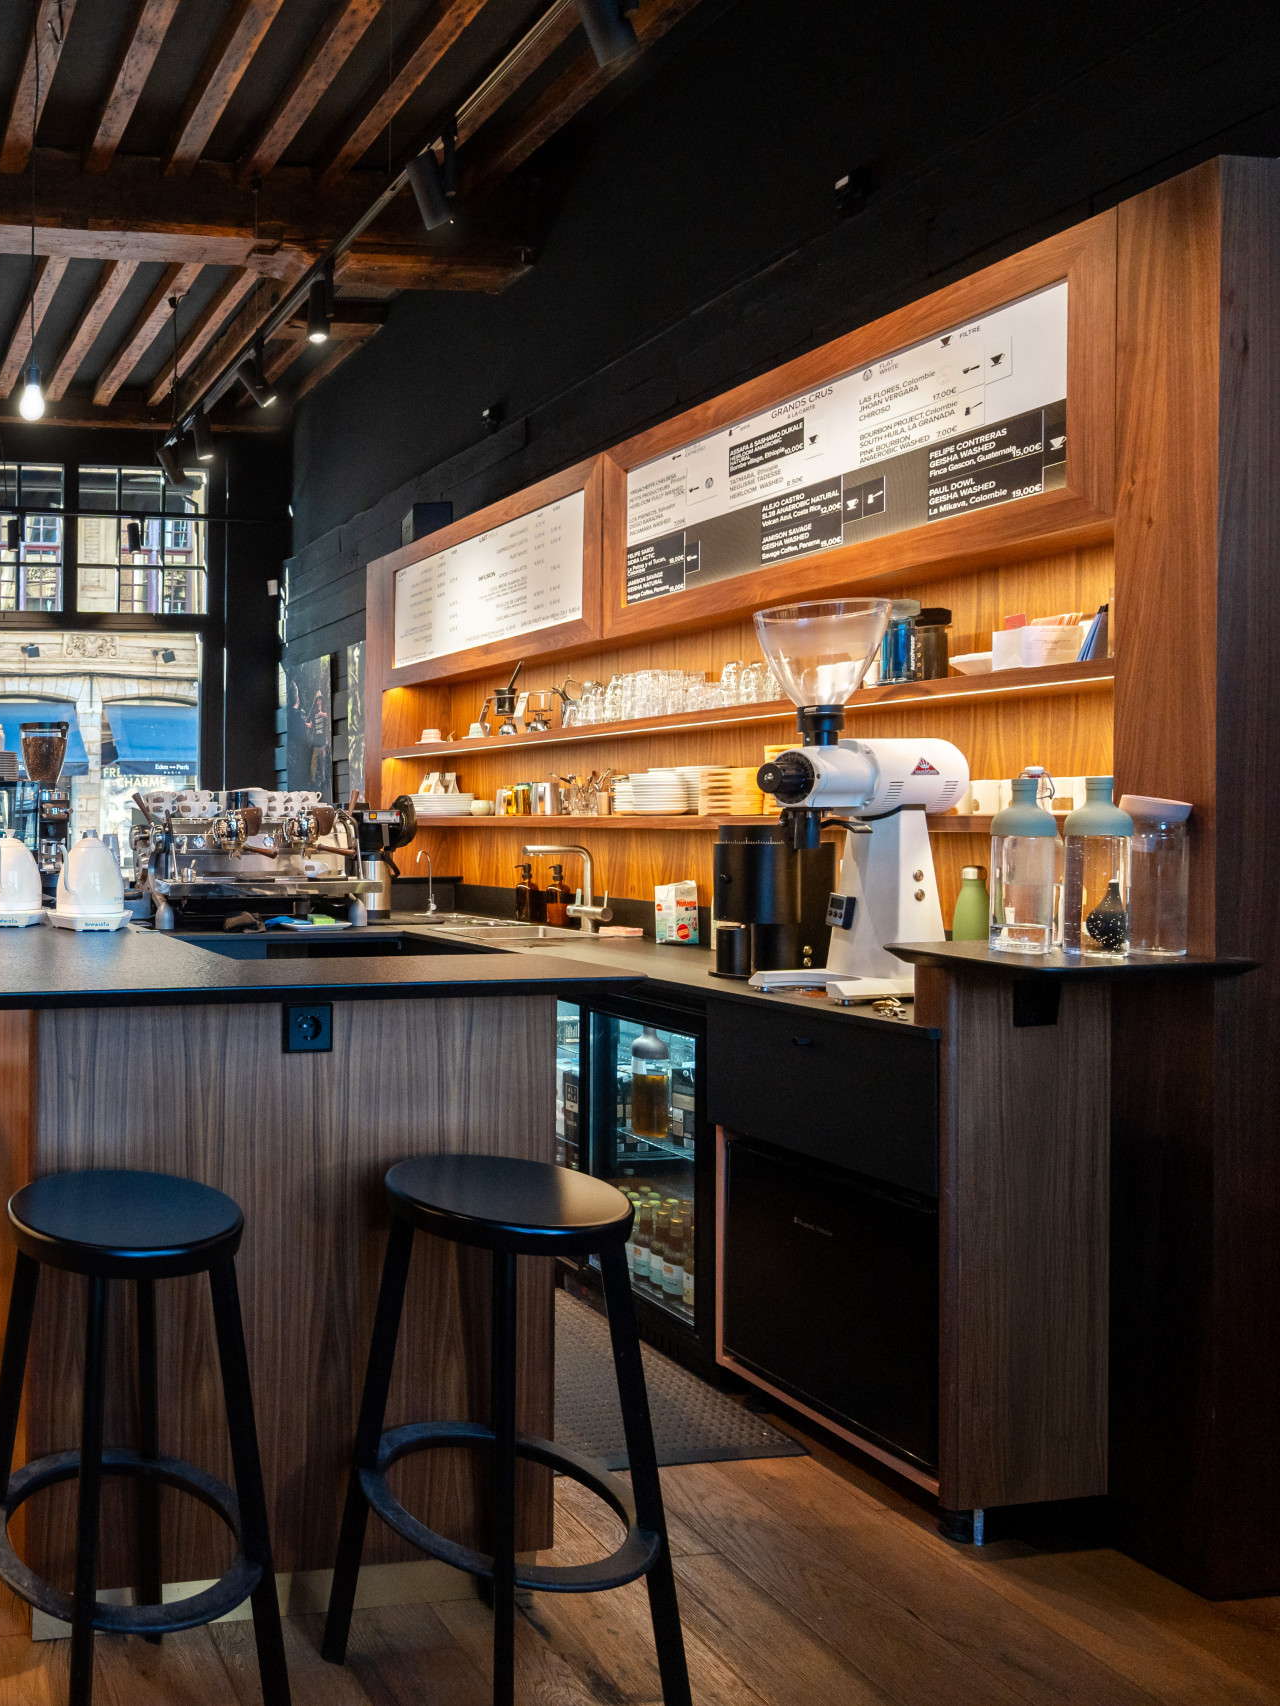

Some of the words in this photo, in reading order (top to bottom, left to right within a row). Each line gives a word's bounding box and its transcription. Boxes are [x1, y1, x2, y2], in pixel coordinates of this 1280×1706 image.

[959, 325, 981, 339] FILTRE
[880, 360, 893, 369] FLAT
[880, 363, 898, 374] WHITE
[859, 396, 871, 405] LAS
[873, 384, 901, 402] FLORES,
[903, 371, 935, 388] Colombie
[771, 397, 806, 419] GRANDS
[809, 387, 833, 403] CRUS
[859, 398, 883, 413] JHOAN
[885, 385, 919, 402] VERGARA
[799, 404, 815, 415] CARTE
[859, 405, 891, 422] CHIROSO
[860, 424, 892, 441] BOURBON
[894, 413, 924, 430] PROJECT,
[925, 401, 958, 417] Colombie
[860, 435, 883, 449] SOUTH
[884, 428, 906, 441] HUILA,
[908, 422, 917, 430] LA
[919, 409, 955, 427] GRANADA
[730, 445, 749, 456] ASSAFA
[781, 422, 803, 436] DUKALE
[730, 448, 753, 461] HEIRLOOM
[754, 437, 782, 452] ANAEROBIC
[860, 448, 874, 457] PINK
[876, 435, 911, 451] BOURBON
[930, 445, 955, 459] FELIPE
[956, 428, 1007, 451] CONTRERAS
[860, 445, 898, 464] ANAEROBIC
[900, 435, 930, 450] WASHED
[929, 453, 959, 468] GEISHA
[960, 441, 996, 459] WASHED
[1012, 443, 1041, 457] 15,00€
[730, 455, 750, 465] NATURAL
[930, 467, 947, 477] Finca
[948, 459, 976, 472] Gascon,
[977, 446, 1016, 462] Guatemala
[730, 480, 755, 492] NEGUSSIE
[757, 469, 781, 483] TADESSE
[730, 486, 757, 500] HEIRLOOM
[760, 477, 783, 490] WASHED
[929, 485, 949, 496] PAUL
[951, 478, 975, 490] DOWL
[1012, 483, 1041, 498] 19,00€
[652, 494, 663, 502] FULLY
[762, 502, 779, 512] ALEJO
[781, 493, 805, 507] CASTRO
[929, 492, 958, 505] GEISHA
[960, 481, 996, 496] WASHED
[929, 507, 937, 515] La
[939, 501, 968, 513] Mikava,
[969, 489, 1007, 504] Colombie
[762, 510, 775, 519] SL28
[776, 499, 810, 515] ANAEROBIC
[811, 490, 839, 504] NATURAL
[762, 518, 779, 527] Volcan
[793, 509, 808, 517] Costa
[762, 531, 787, 543] JAMISON
[788, 523, 812, 536] SAVAGE
[762, 540, 783, 551] GEISHA
[784, 533, 809, 544] WASHED
[640, 553, 655, 561] LACTIC
[762, 550, 780, 559] Savage
[799, 539, 820, 549] Panama
[627, 585, 642, 593] GEISHA
[643, 579, 663, 588] NATURAL
[628, 577, 645, 586] JAMISON
[646, 571, 663, 580] SAVAGE
[117, 778, 166, 787] CHARME
